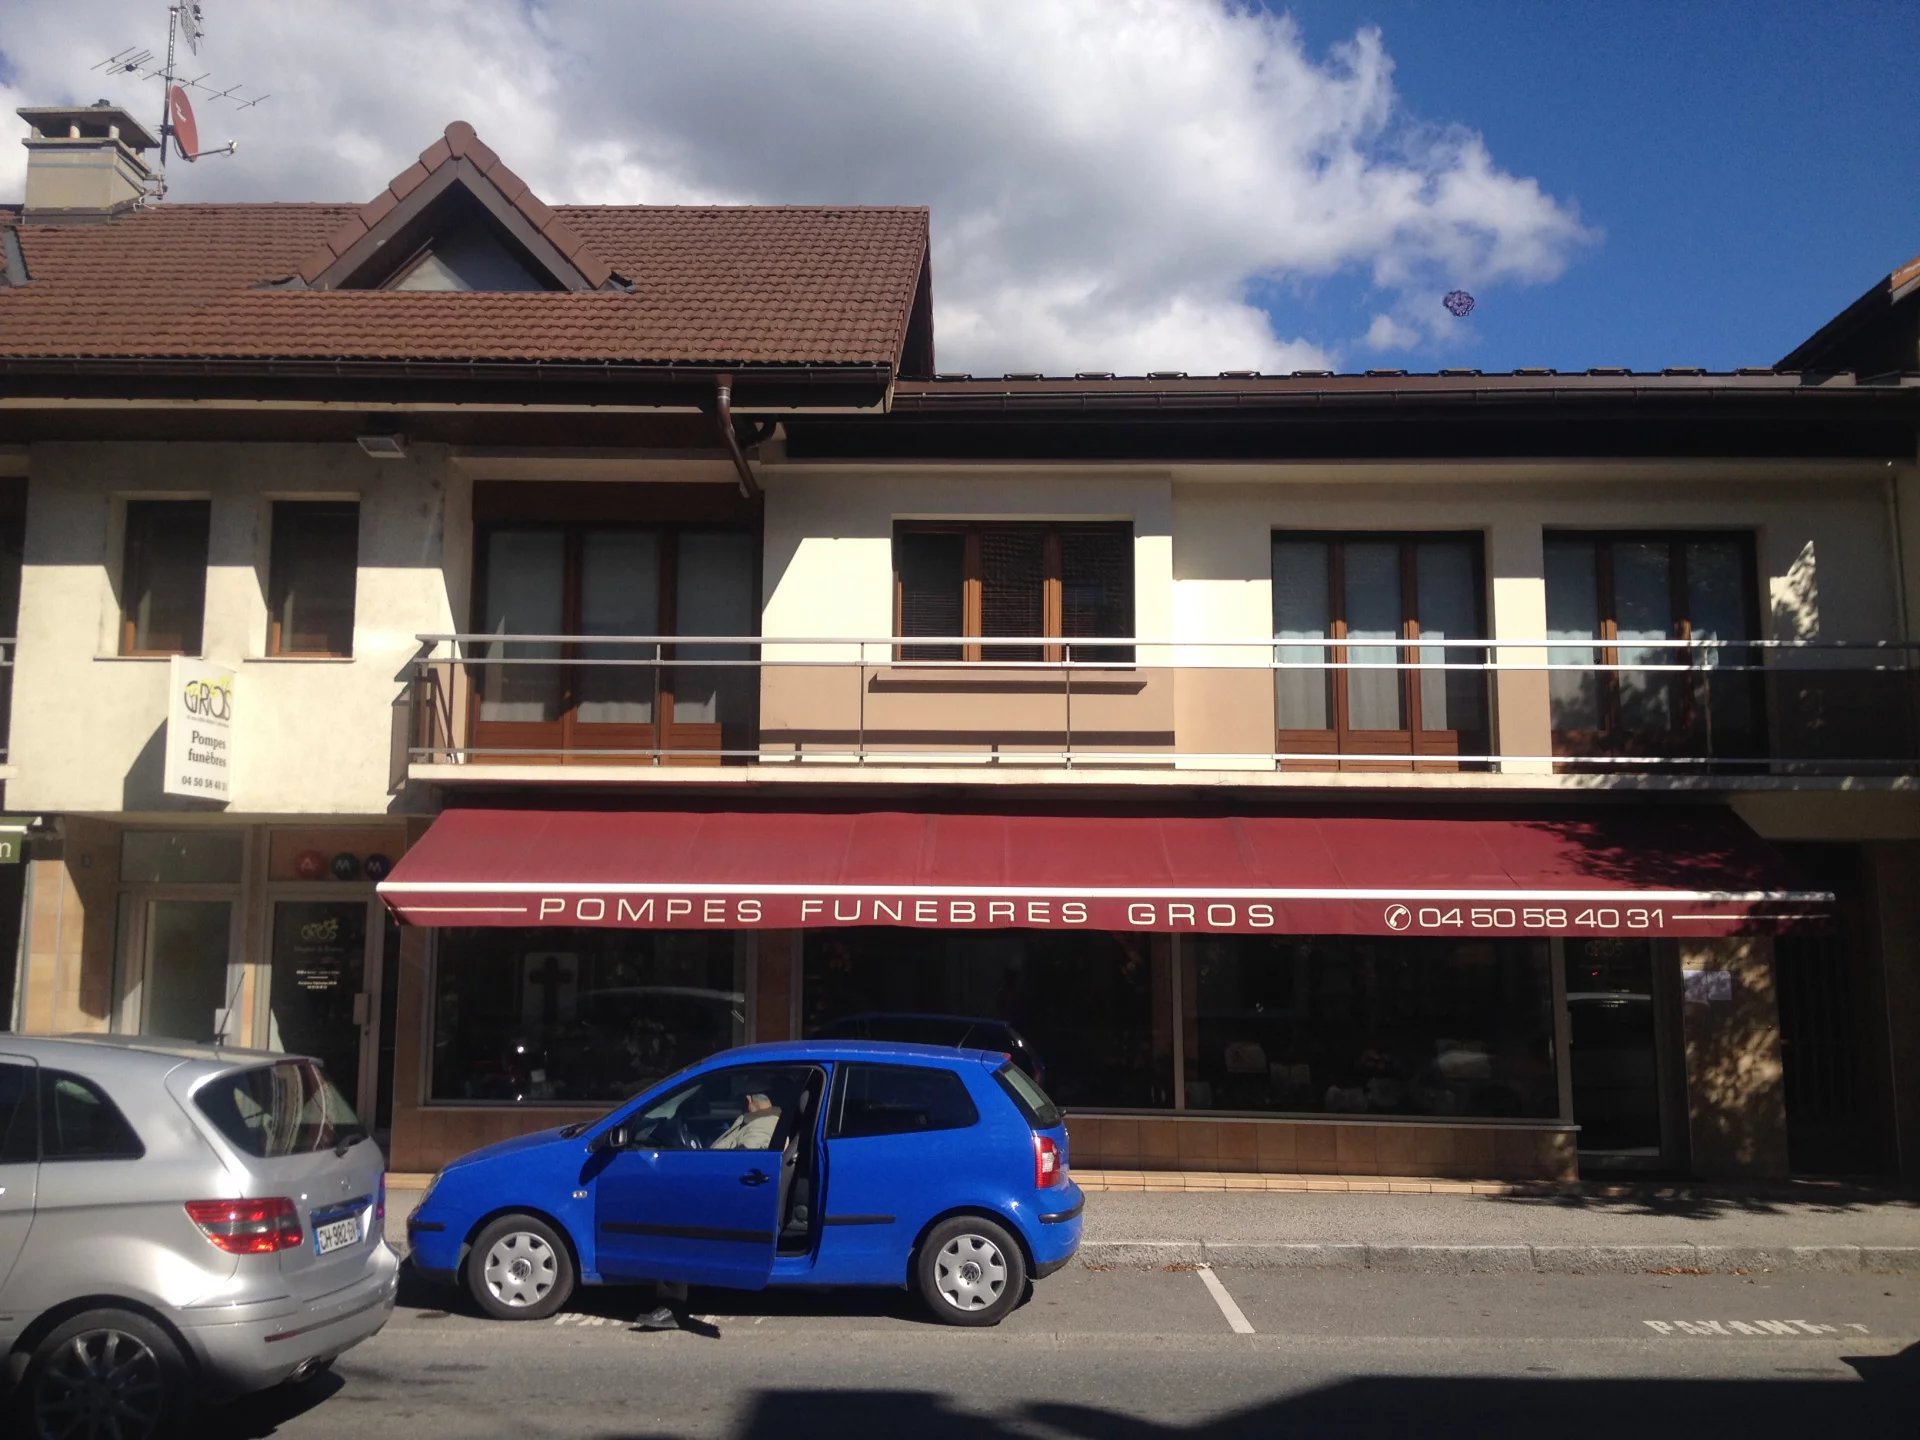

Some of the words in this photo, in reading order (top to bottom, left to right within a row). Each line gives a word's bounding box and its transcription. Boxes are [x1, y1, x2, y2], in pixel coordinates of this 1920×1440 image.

[184, 680, 232, 721] GROS
[191, 730, 226, 750] Pompes
[188, 748, 227, 768] funèbres
[181, 775, 192, 786] 04
[193, 777, 203, 787] 50
[539, 898, 763, 923] POMPES
[801, 899, 1088, 923] FUNEBRES
[1128, 903, 1275, 928] GROS
[1418, 907, 1464, 928] 04
[1471, 908, 1516, 928] 50
[1522, 908, 1568, 928] 58
[1574, 908, 1620, 928] 40
[1626, 908, 1664, 928] 31
